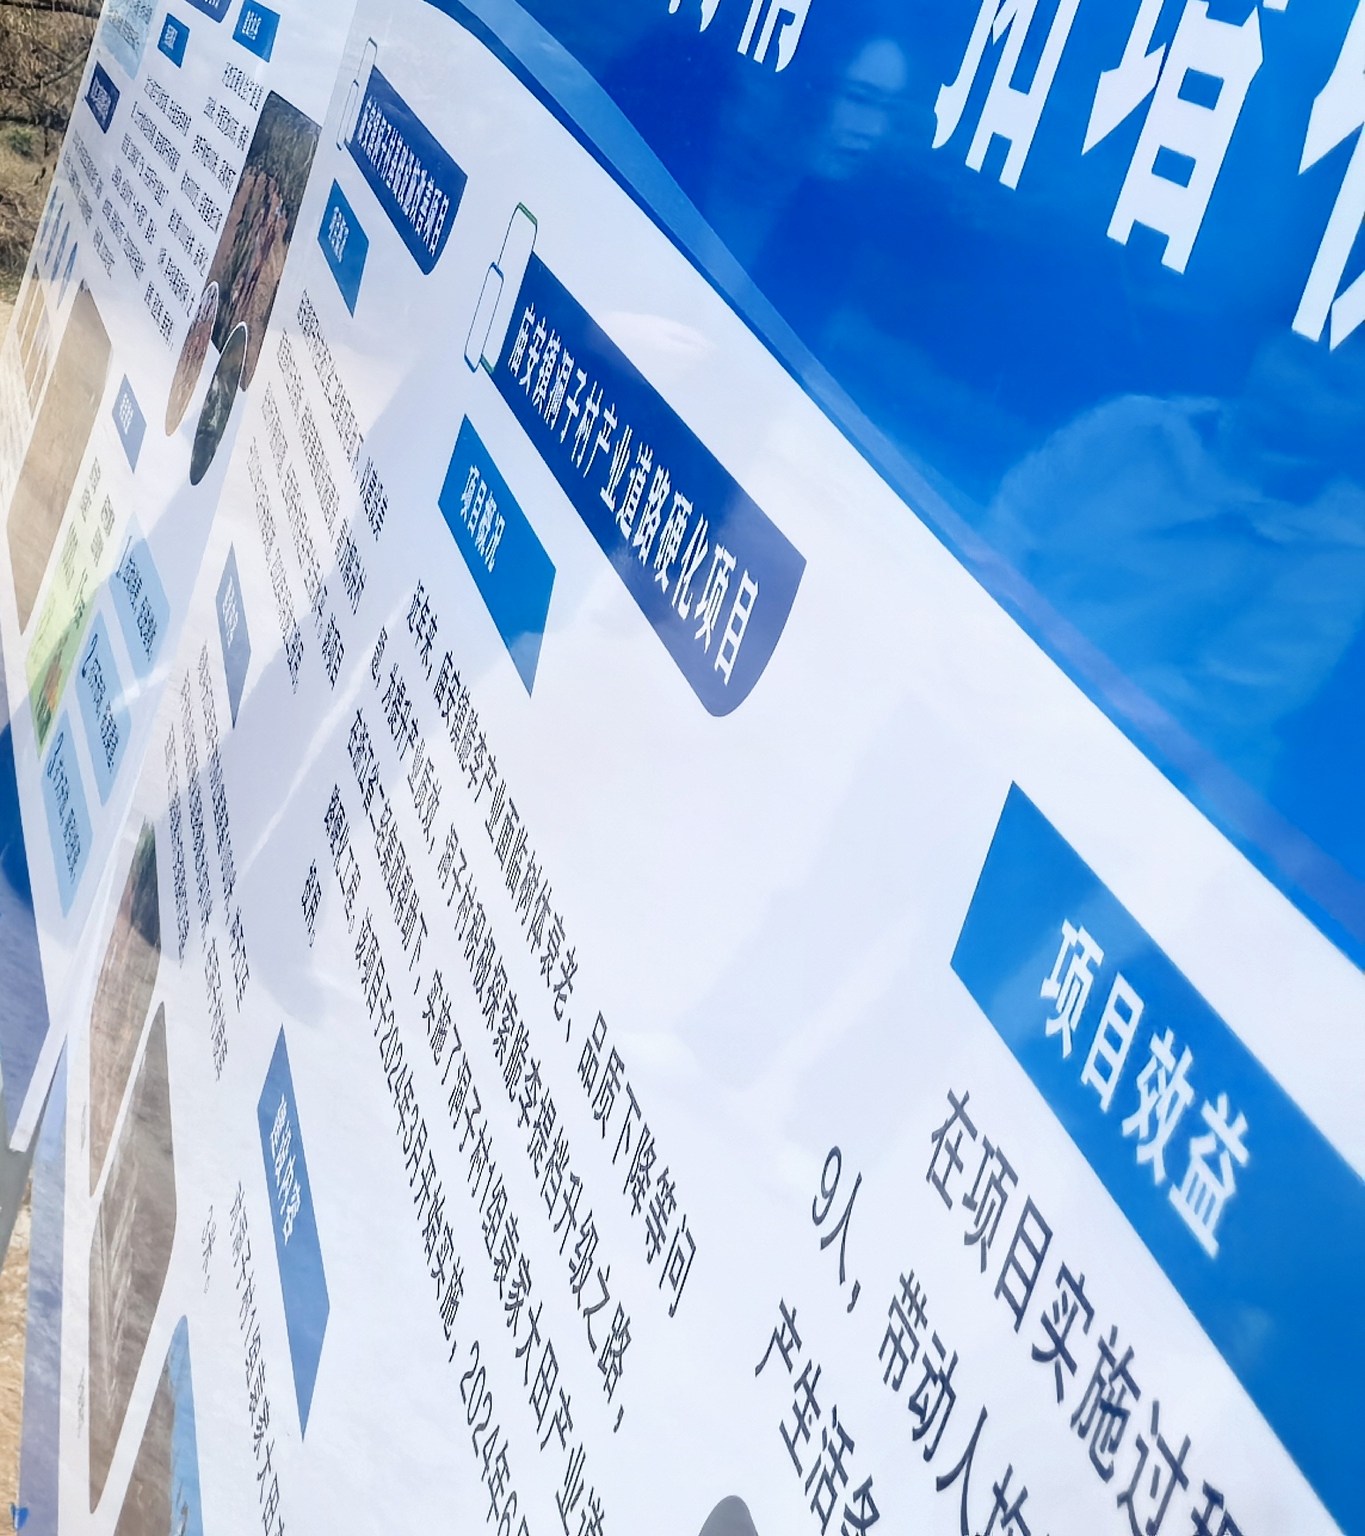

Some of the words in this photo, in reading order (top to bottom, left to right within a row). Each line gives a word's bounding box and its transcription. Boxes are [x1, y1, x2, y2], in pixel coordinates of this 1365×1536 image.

[460, 464, 507, 573] 项目概况
[506, 302, 759, 687] 庙安镇洞子村产业道路硬化项目
[269, 1093, 302, 1246] 建设内容
[1040, 919, 1249, 1259] 项目效益
[230, 1180, 284, 1536] 对洞子村1组袁家大田
